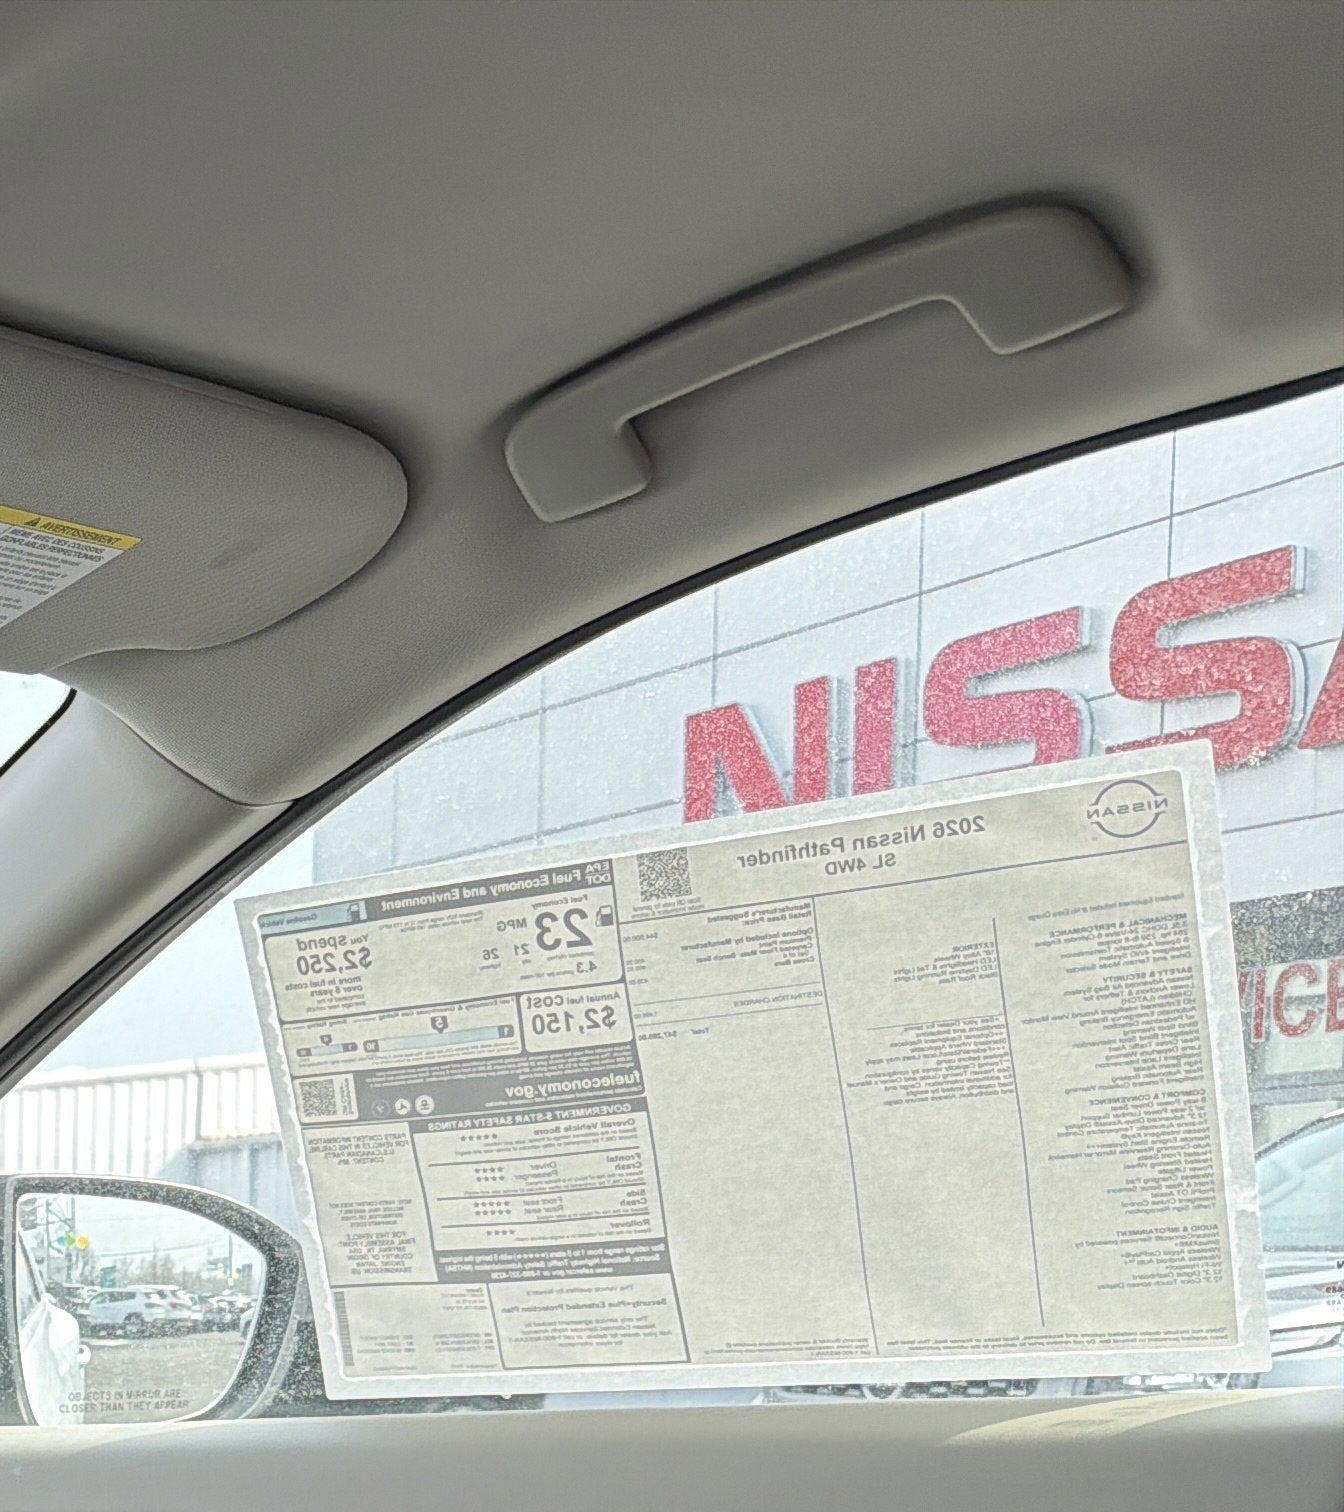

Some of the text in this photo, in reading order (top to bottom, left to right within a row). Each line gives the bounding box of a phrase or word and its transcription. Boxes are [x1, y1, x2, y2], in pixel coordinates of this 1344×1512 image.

[39, 521, 122, 546] AVERTISSEMENT
[684, 545, 1344, 822] NISS
[68, 1388, 182, 1402] OBJECTS IN MIRROR ARE
[59, 1399, 190, 1413] CLOSER THAN THEY APPEAR
